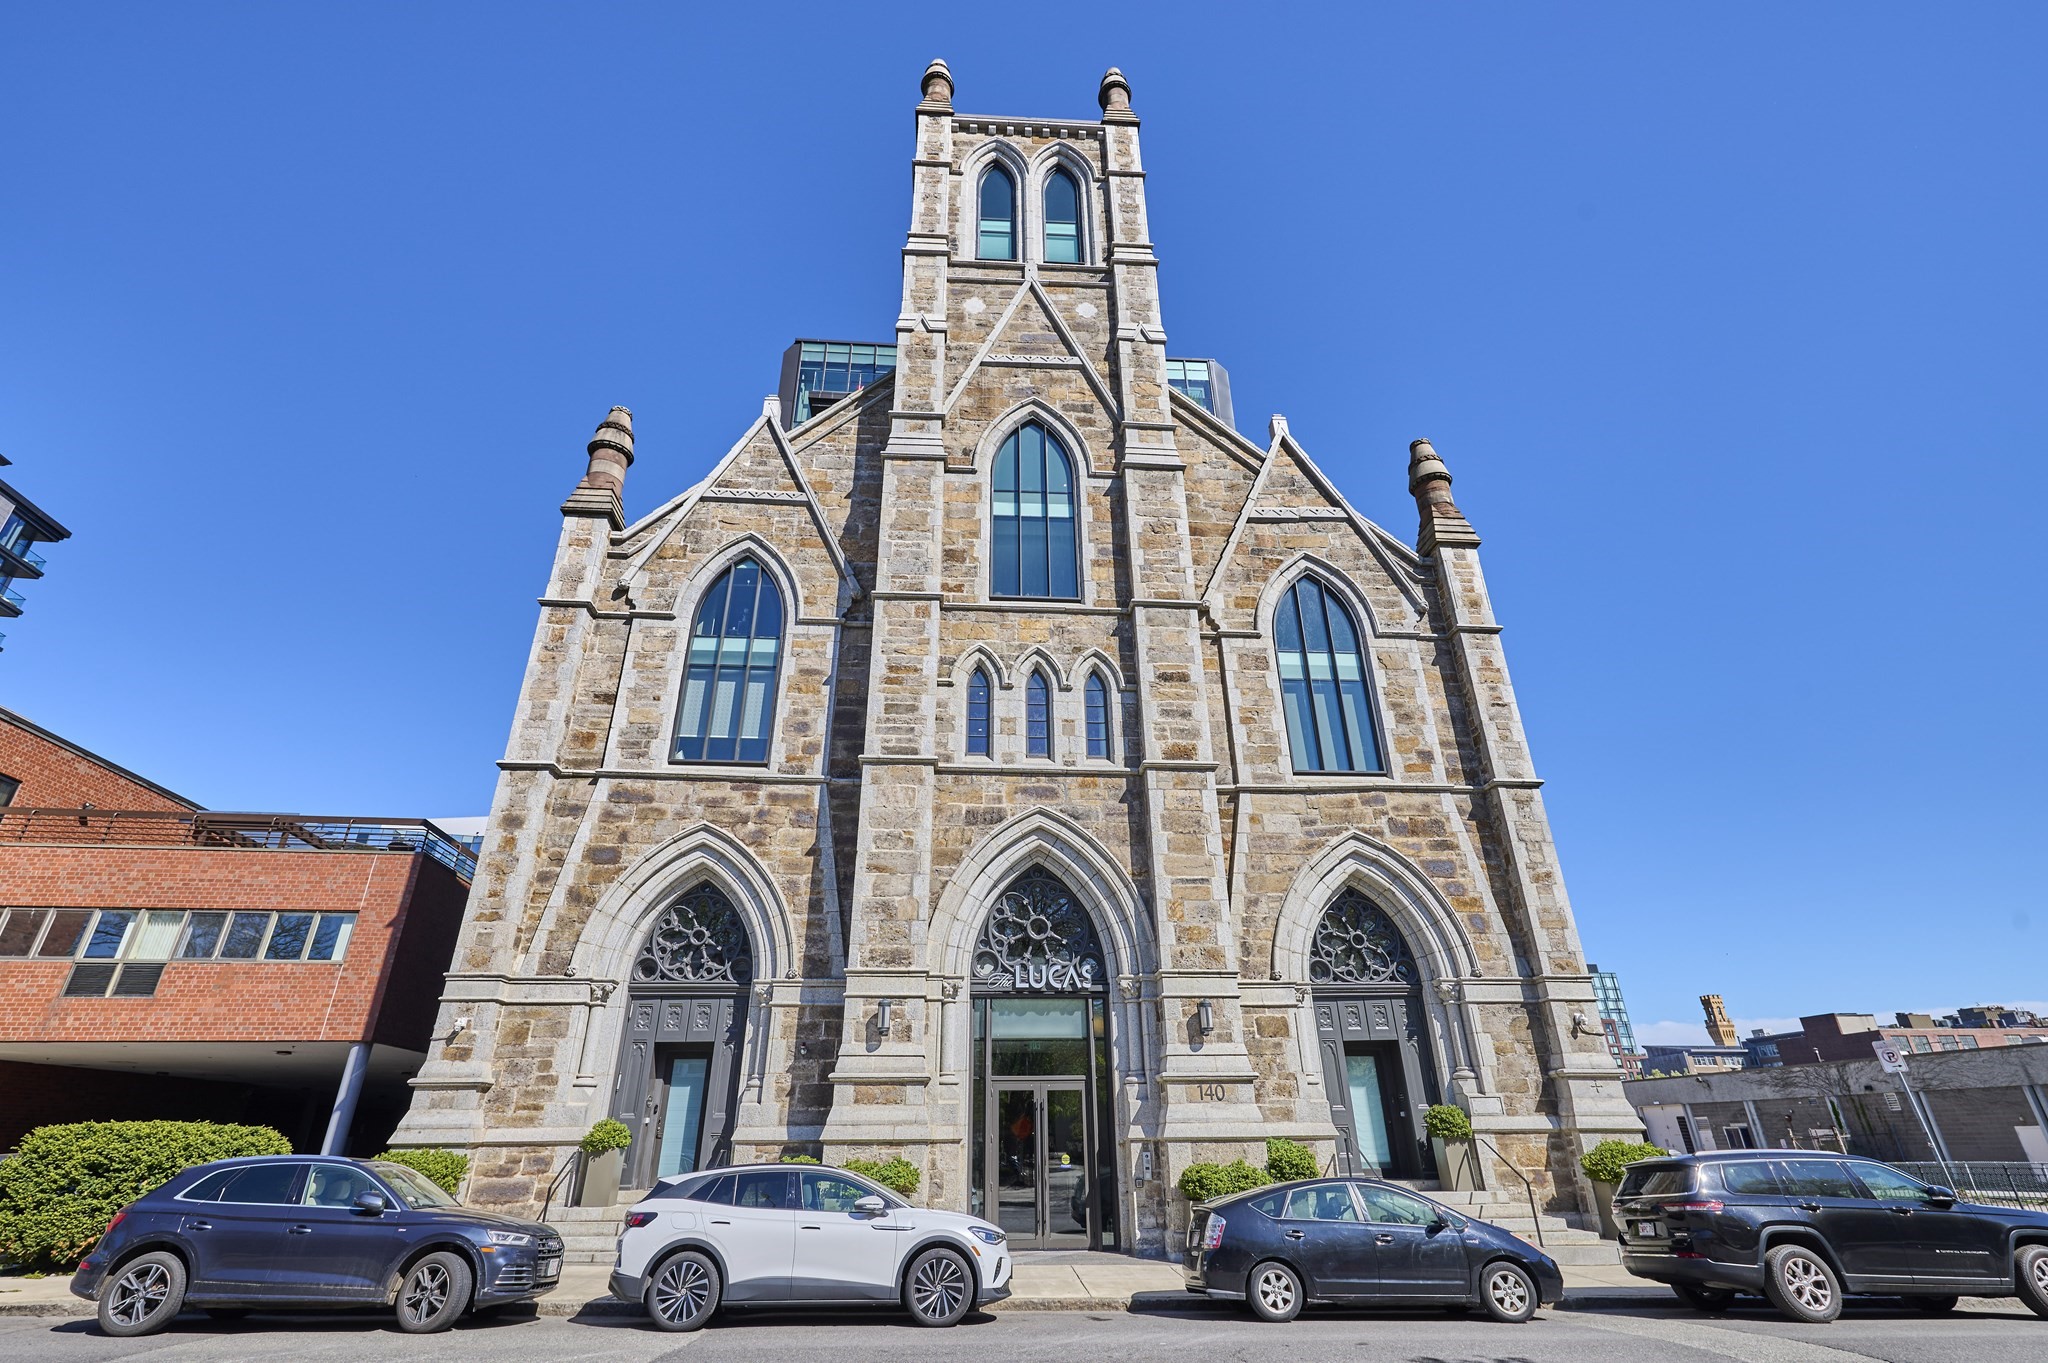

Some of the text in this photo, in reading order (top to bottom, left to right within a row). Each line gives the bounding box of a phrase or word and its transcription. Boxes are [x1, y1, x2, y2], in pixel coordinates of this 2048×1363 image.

[987, 964, 1092, 989] The LUCAS
[1196, 1082, 1225, 1101] 140
